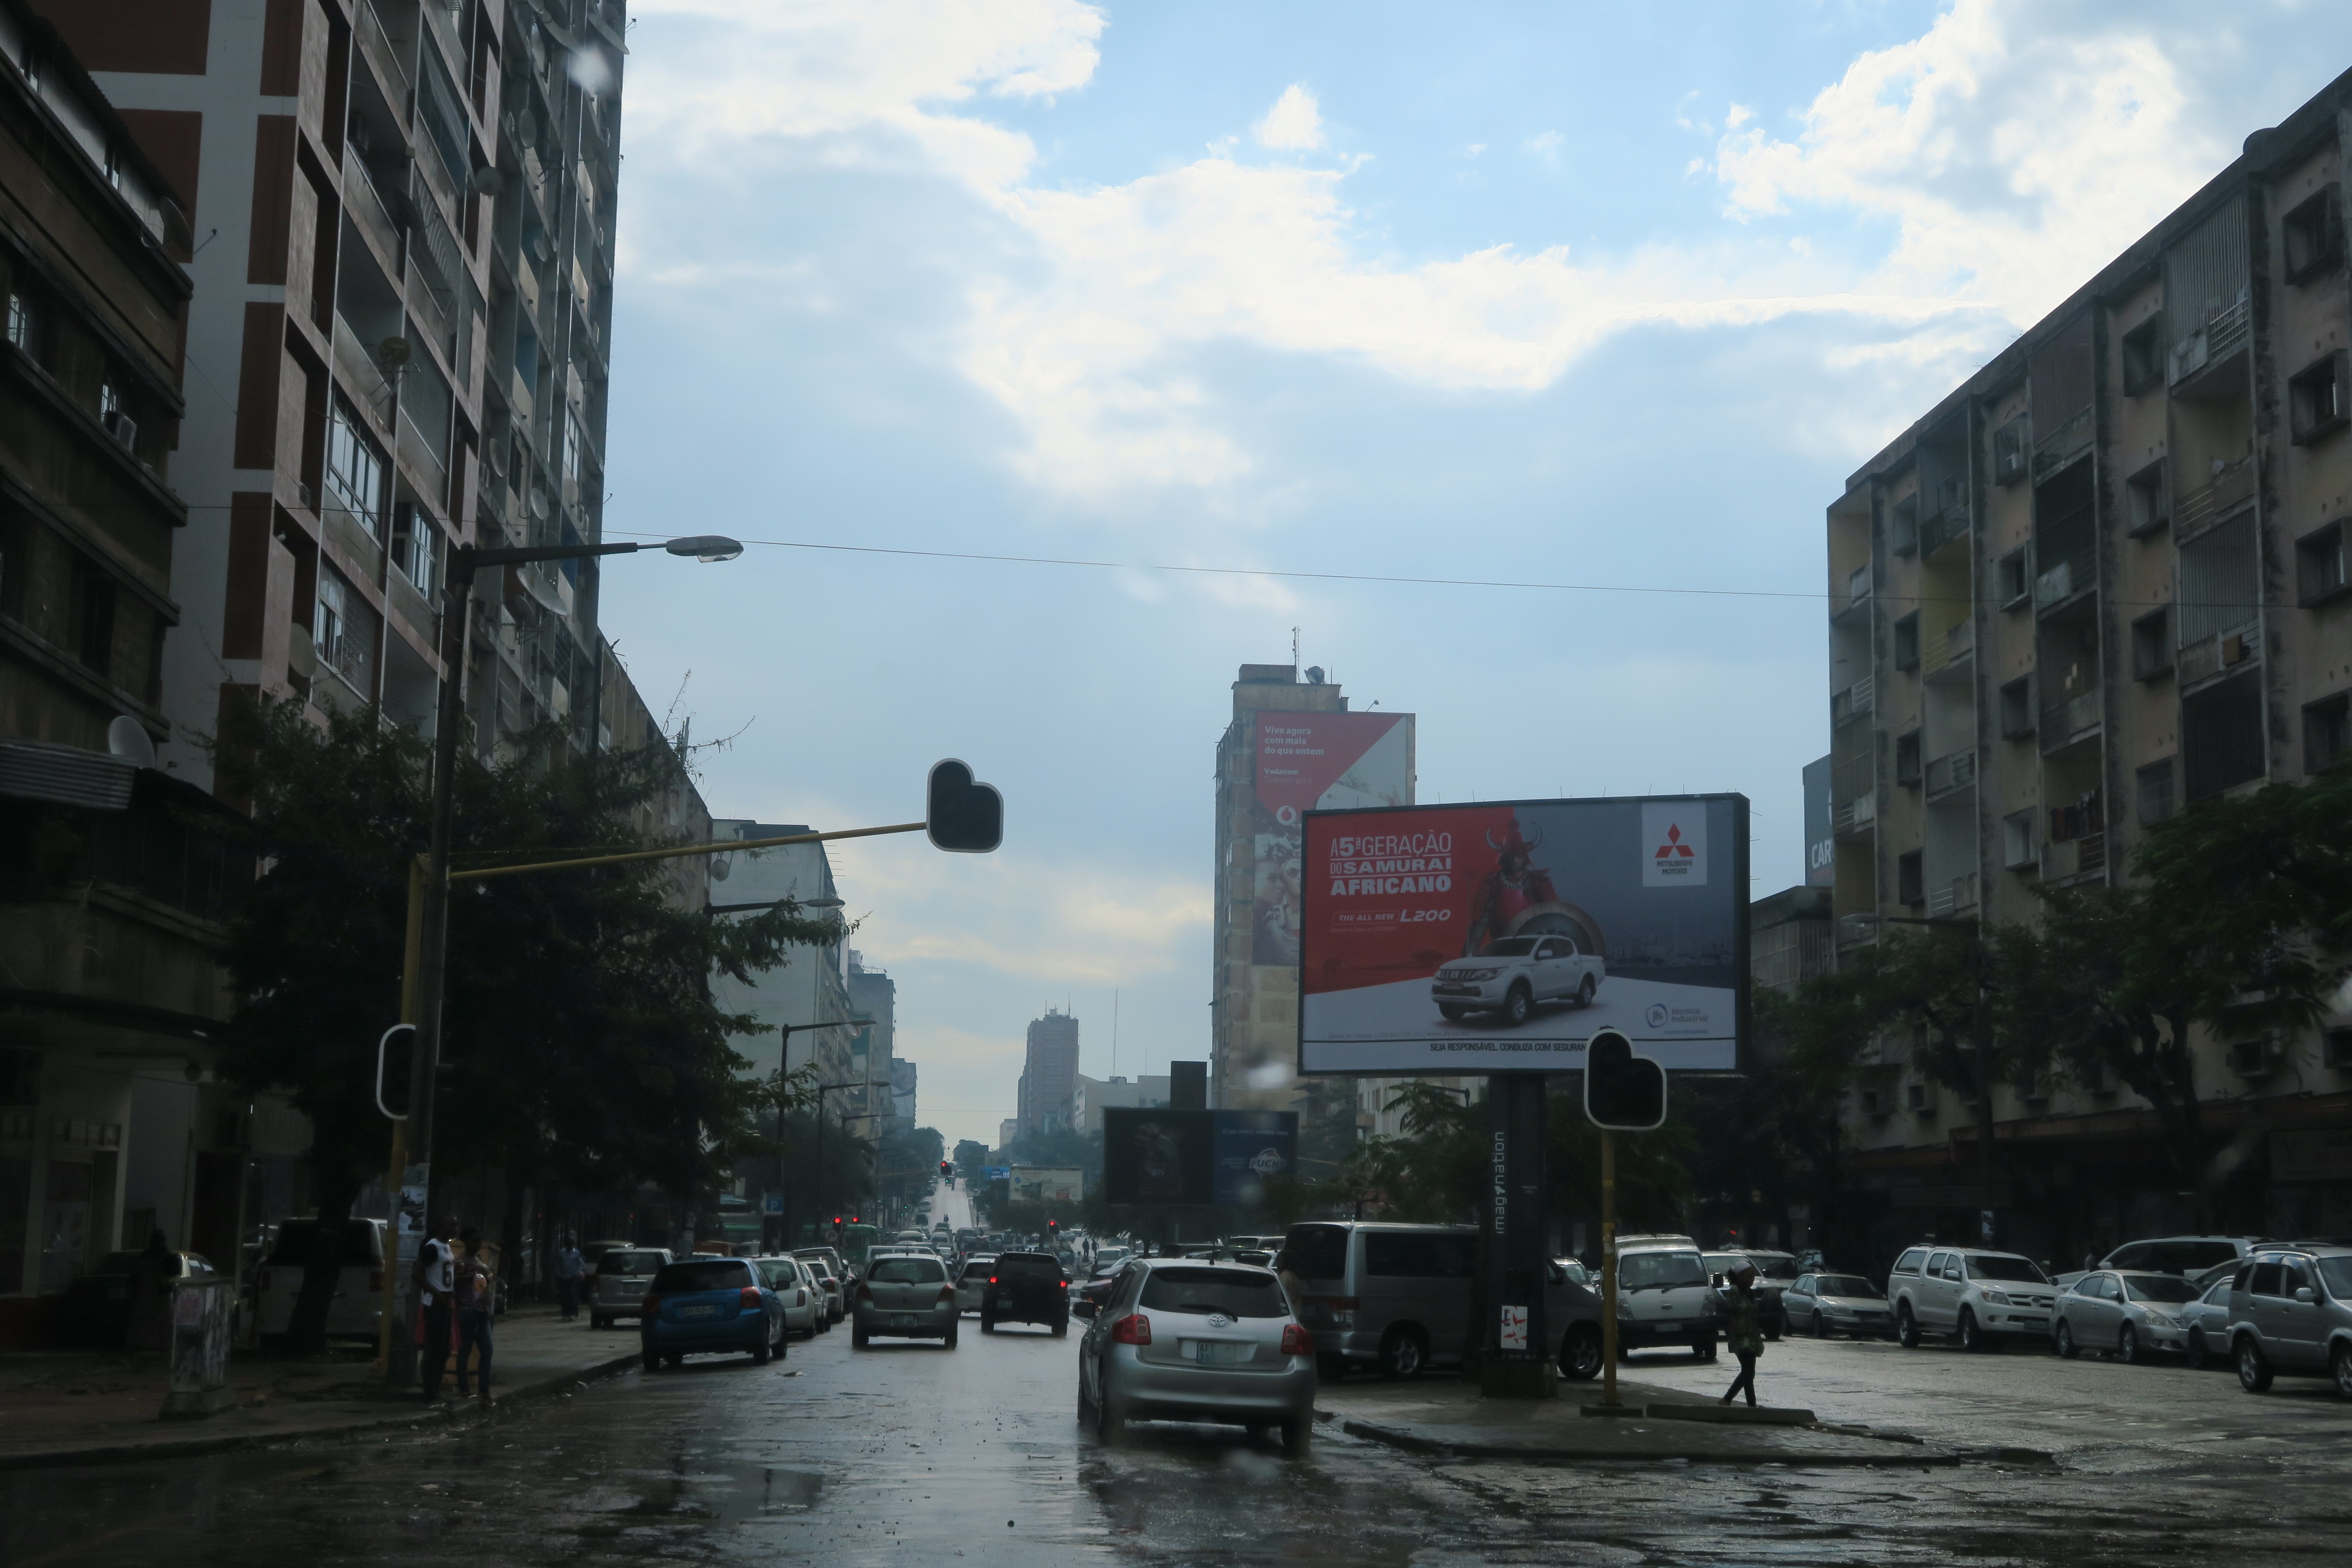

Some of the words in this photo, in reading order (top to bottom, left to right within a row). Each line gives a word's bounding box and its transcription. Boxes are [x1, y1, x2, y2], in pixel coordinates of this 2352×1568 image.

[1286, 728, 1311, 736] agora
[1331, 839, 1338, 857] A
[1362, 829, 1452, 857] GERAÇÃO
[1330, 863, 1341, 874] DO
[1343, 858, 1452, 874] SAMURAI
[1331, 875, 1452, 895] AFRICANO
[1400, 909, 1451, 922] L200
[1671, 1014, 1708, 1023] industrial
[1430, 1043, 1446, 1051] SEJA
[1500, 1043, 1533, 1051] CONDUZA
[1534, 1043, 1551, 1051] COM
[1553, 1043, 1586, 1051] SEGURAN
[1251, 1159, 1286, 1169] FUCHS
